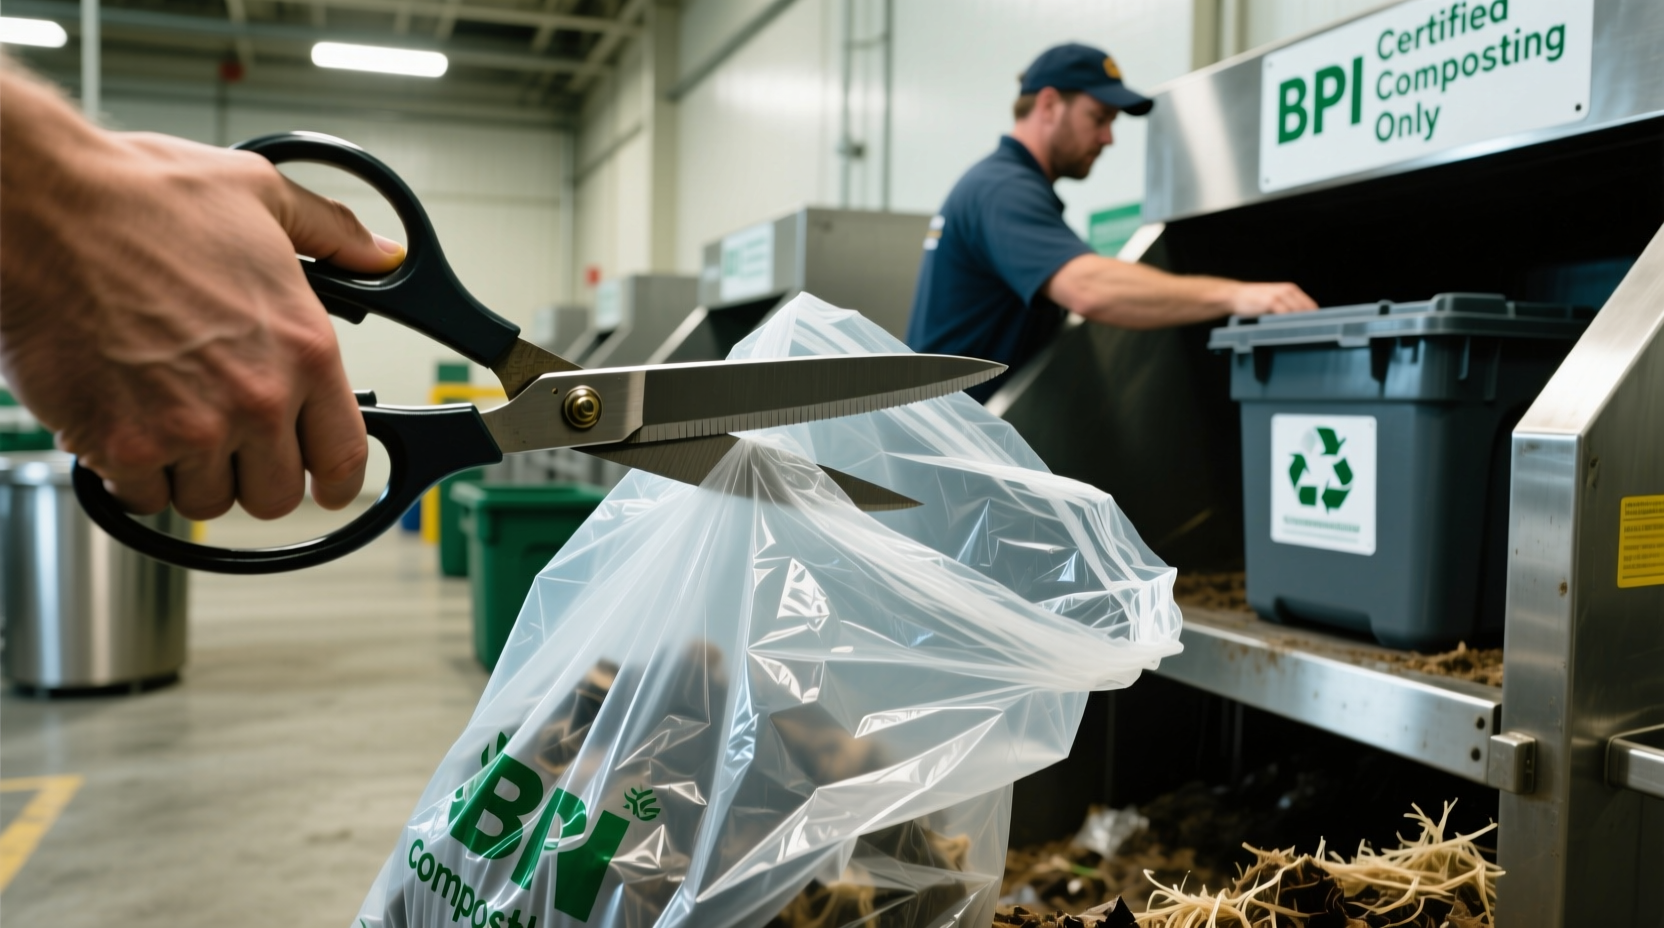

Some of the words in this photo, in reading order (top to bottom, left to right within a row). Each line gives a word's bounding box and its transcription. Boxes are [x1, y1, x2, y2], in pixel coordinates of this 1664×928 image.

[1376, 24, 1566, 101] Composting
[1377, 0, 1508, 60] Certified
[1277, 56, 1363, 145] BPI
[1375, 102, 1441, 142] Only
